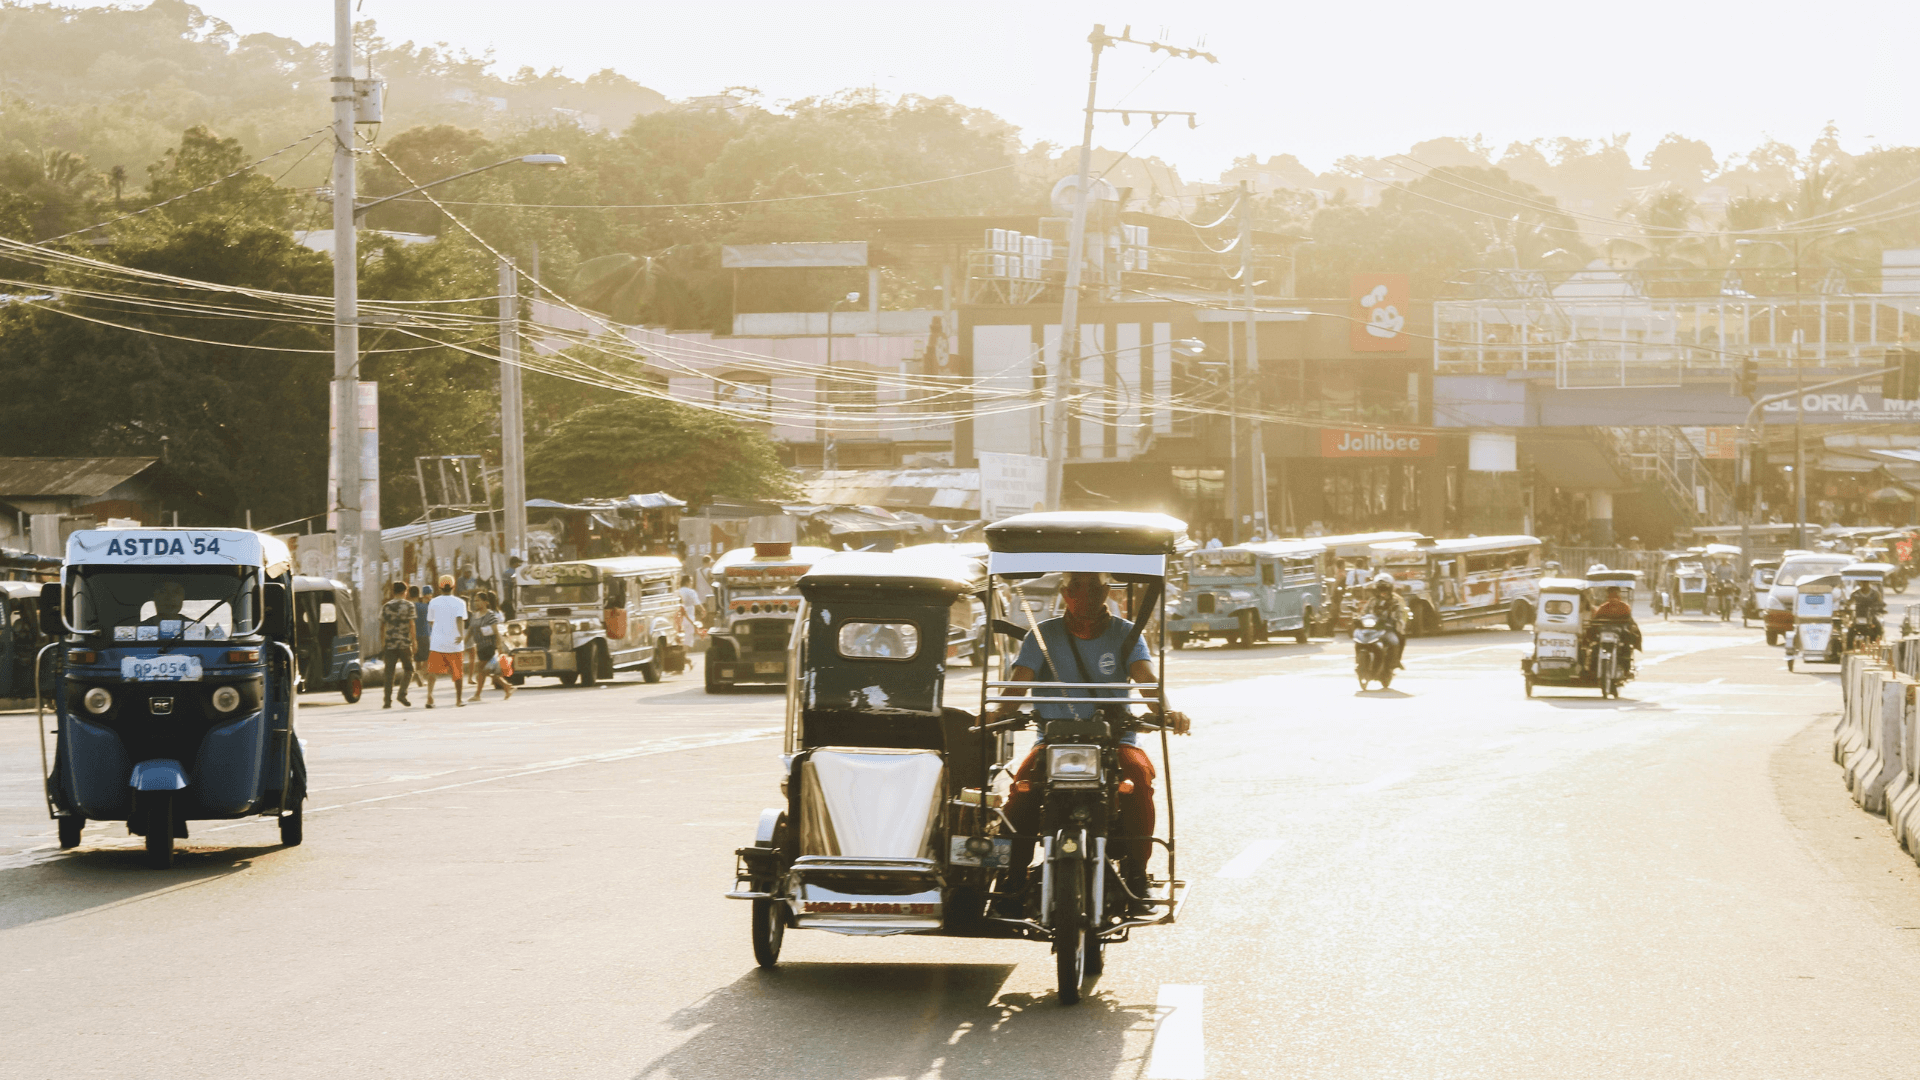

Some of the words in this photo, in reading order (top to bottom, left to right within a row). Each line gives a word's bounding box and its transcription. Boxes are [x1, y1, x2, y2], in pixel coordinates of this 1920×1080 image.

[1763, 394, 1868, 412] GLORIA
[1337, 431, 1420, 451] Jollibee
[106, 538, 185, 556] ASTDA
[193, 537, 220, 555] 54
